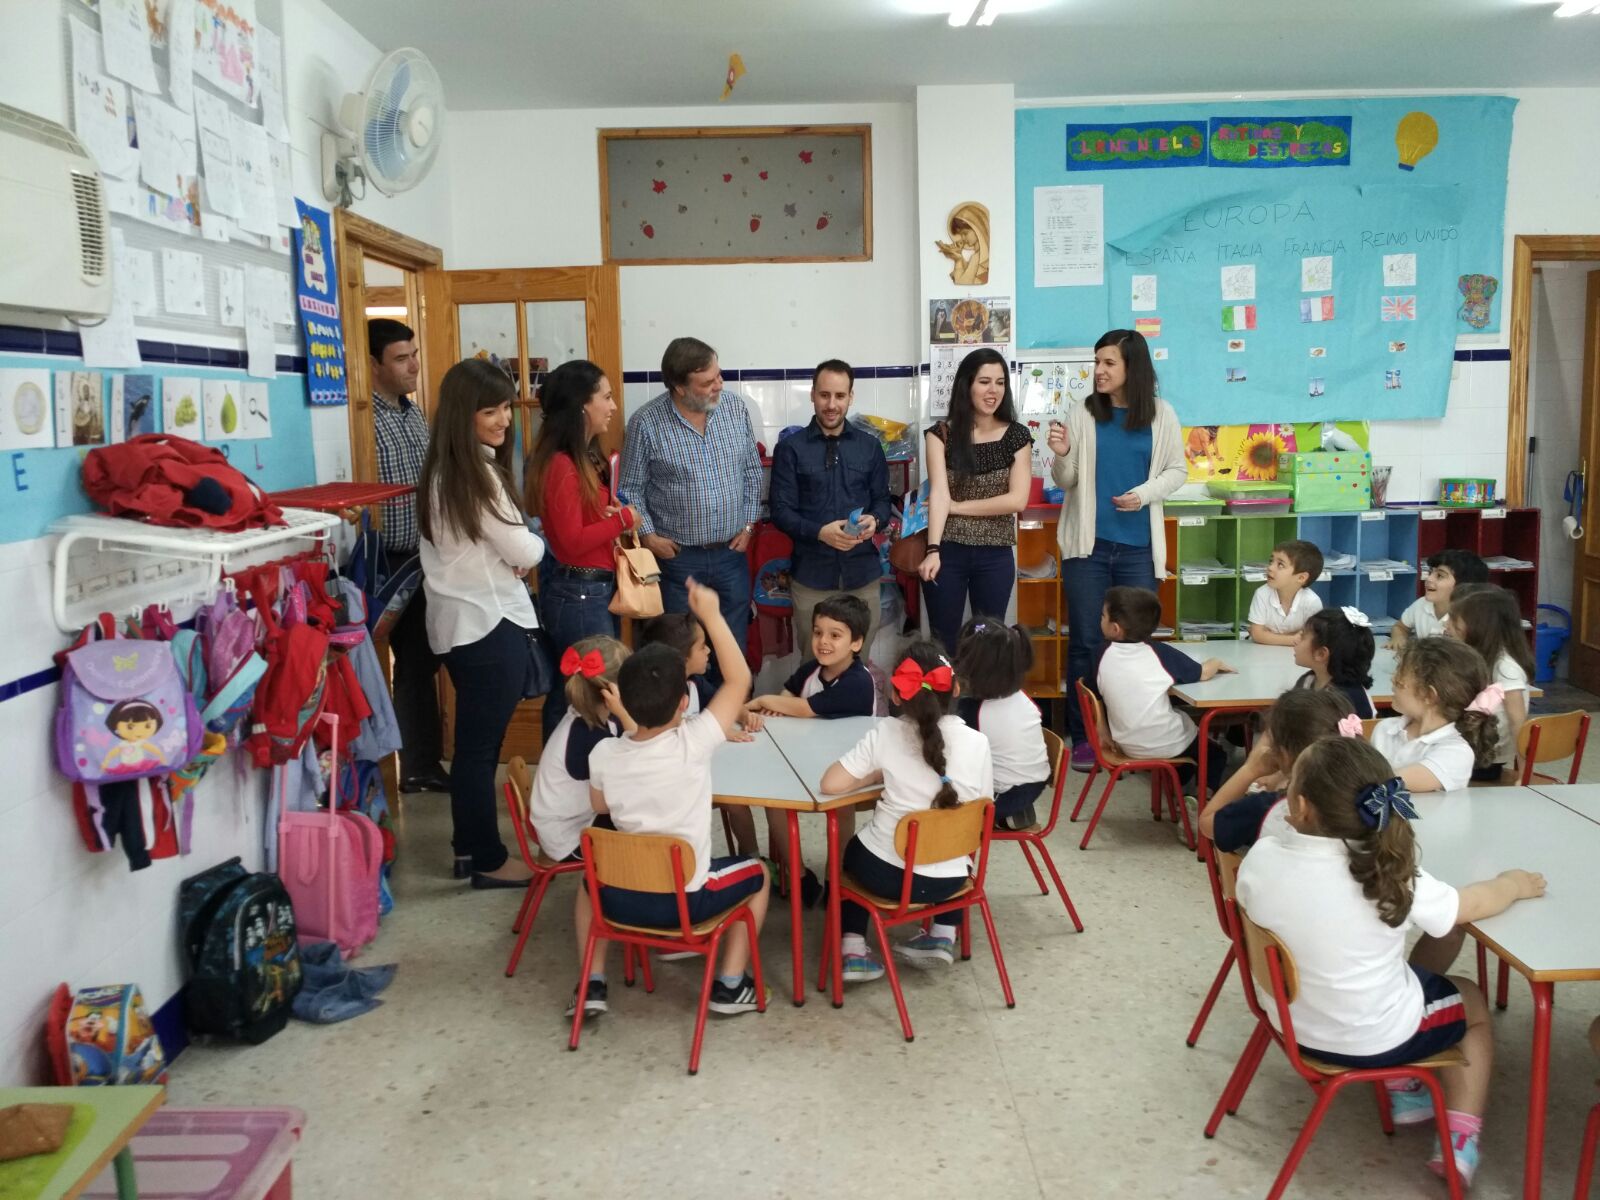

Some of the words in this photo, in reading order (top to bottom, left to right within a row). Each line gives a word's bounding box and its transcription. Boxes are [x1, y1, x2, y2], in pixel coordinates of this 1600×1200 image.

[1294, 124, 1304, 141] Y
[1247, 141, 1342, 158] DESTREZAS
[1183, 200, 1316, 232] EUROPA
[1284, 237, 1346, 256] FRANCIA
[1360, 230, 1409, 249] REINO
[1415, 228, 1459, 243] UNIDO
[1125, 246, 1198, 267] ESPAÑA
[1217, 242, 1264, 262] ITALIA
